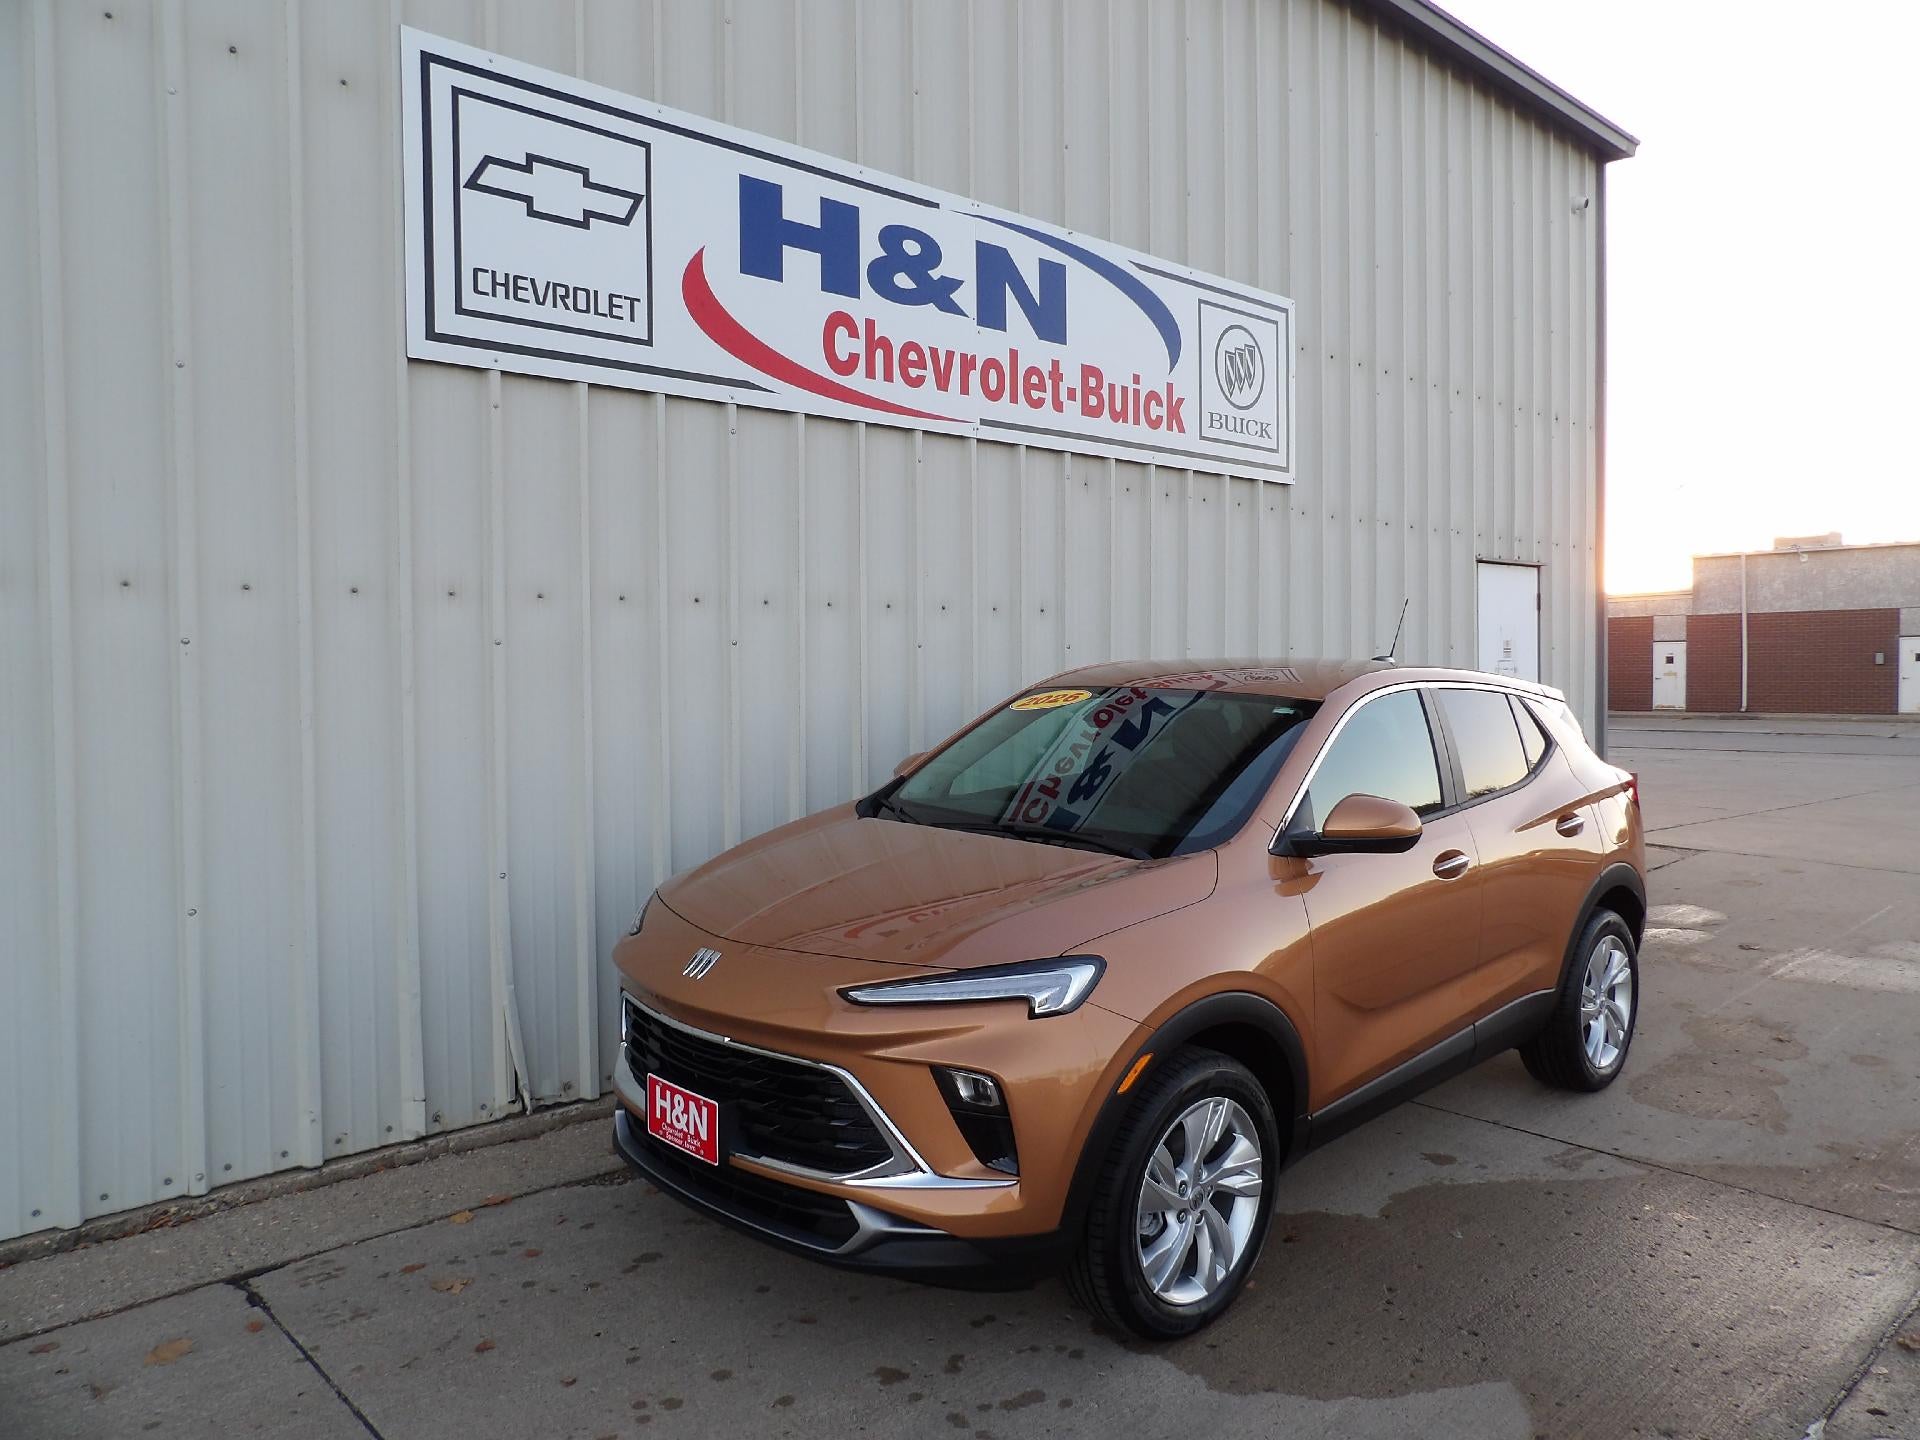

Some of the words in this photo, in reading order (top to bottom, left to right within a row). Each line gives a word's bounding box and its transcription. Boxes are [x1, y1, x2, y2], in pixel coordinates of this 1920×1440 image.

[739, 174, 1067, 346] H&N
[472, 267, 641, 323] CHEVROLET
[822, 310, 1187, 434] Chevrolet-Buick
[1207, 411, 1273, 440] BUICK
[1016, 692, 1085, 708] 2026
[655, 1084, 708, 1141] H&N
